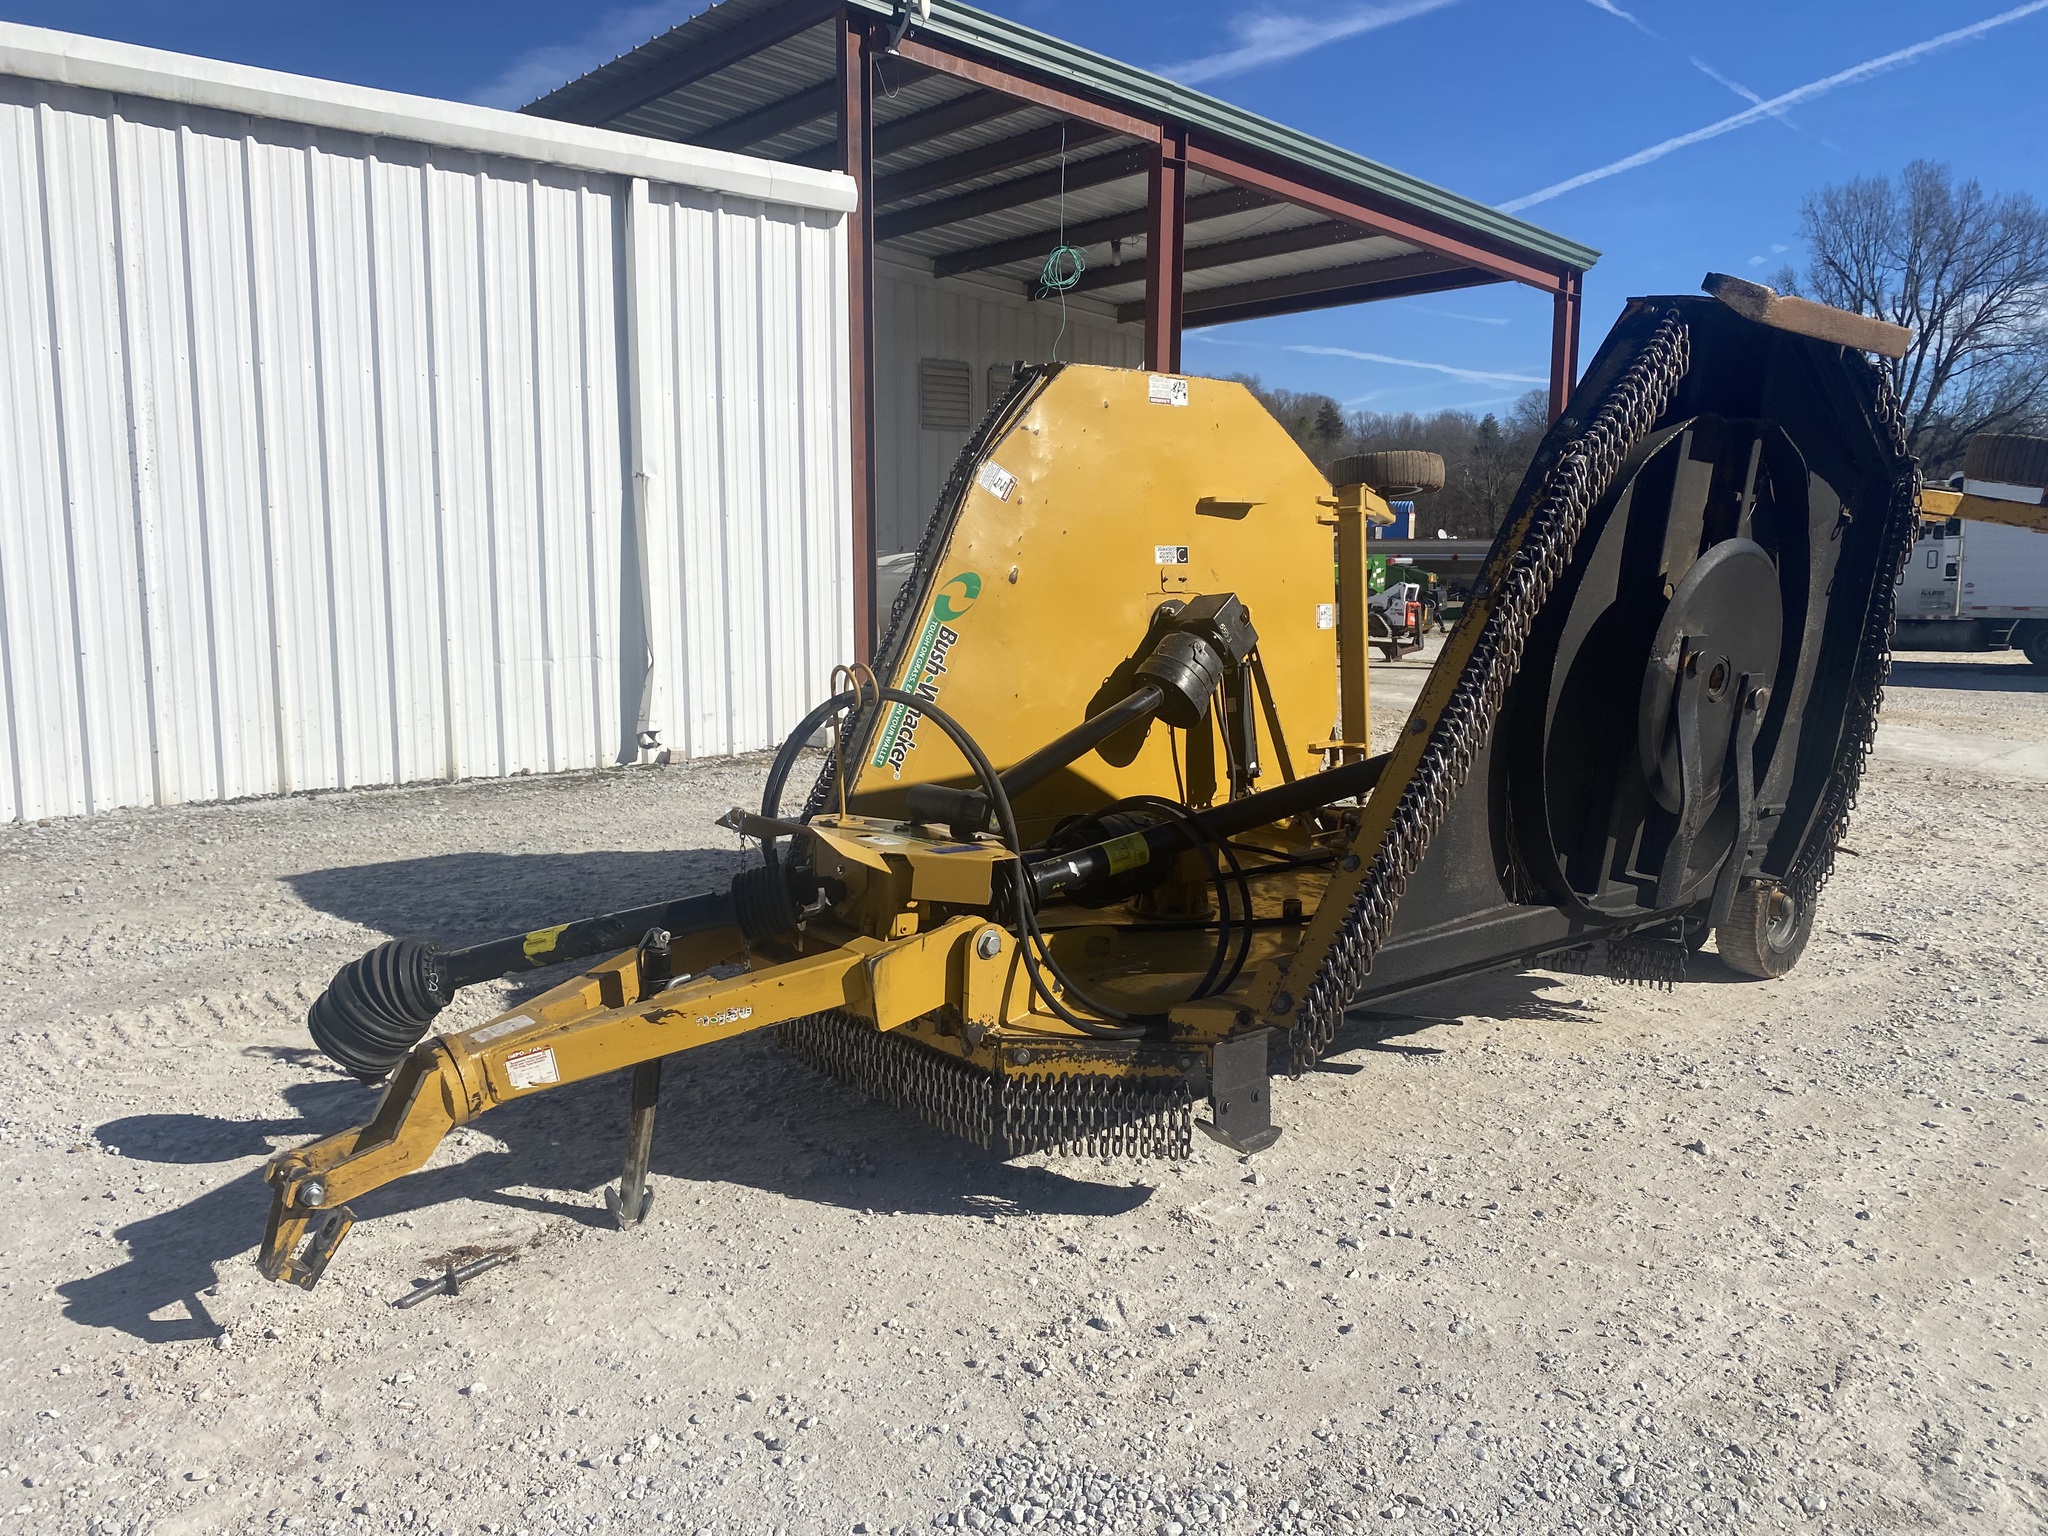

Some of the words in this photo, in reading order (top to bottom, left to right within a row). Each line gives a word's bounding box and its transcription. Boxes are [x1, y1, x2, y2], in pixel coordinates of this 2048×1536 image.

[924, 621, 938, 646] TOUGH
[918, 647, 928, 659] ON
[908, 658, 923, 683] GRASS,
[896, 703, 905, 715] ON
[888, 714, 900, 736] YOUR
[877, 735, 892, 765] WALLET
